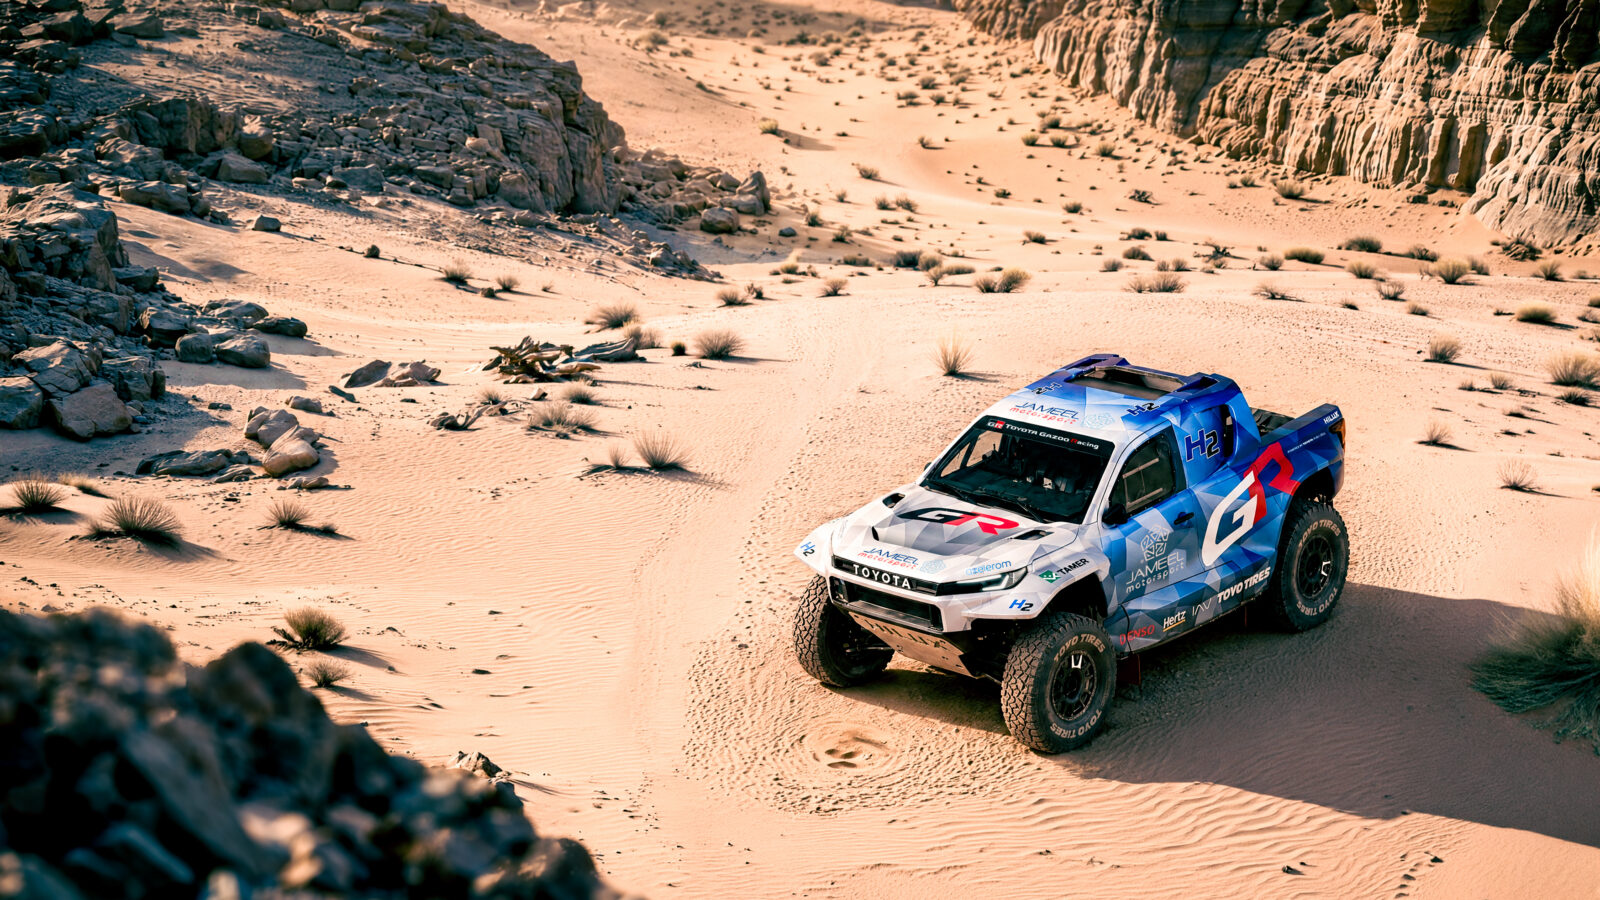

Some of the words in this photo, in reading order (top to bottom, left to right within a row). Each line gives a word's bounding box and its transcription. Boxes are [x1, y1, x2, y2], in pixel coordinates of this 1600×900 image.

[1009, 407, 1077, 425] motorsport
[1016, 402, 1079, 419] JAMEEL
[1127, 402, 1159, 417] H2
[1323, 411, 1340, 424] HILUX
[987, 420, 1005, 429] GR
[1005, 423, 1038, 435] TOYOTA
[1039, 431, 1070, 442] GAZOO
[1070, 438, 1100, 450] Racing
[1184, 429, 1220, 462] H2
[1201, 441, 1301, 567] GR
[897, 507, 1020, 536] GR
[1299, 522, 1319, 547] TOYO
[1319, 519, 1341, 537] TIRES
[800, 541, 816, 557] H2
[863, 548, 919, 565] JAMEEL
[857, 552, 917, 570] motorsport
[1056, 558, 1090, 575] TAMER
[1125, 551, 1185, 585] JAMEEL
[852, 564, 912, 590] TOYOTA
[1125, 563, 1185, 594] motorsport
[1217, 581, 1244, 604] TOYO
[1243, 566, 1271, 590] TIRES
[1009, 599, 1034, 612] H2
[1296, 601, 1318, 616] TIRES
[1318, 587, 1338, 614] TOYO
[1163, 610, 1187, 630] Hertz
[1119, 624, 1156, 646] DENSO
[1053, 636, 1079, 662] TOYO
[1080, 633, 1106, 653] TIRES
[1049, 722, 1077, 740] TIRES
[1077, 708, 1103, 736] TOYO
